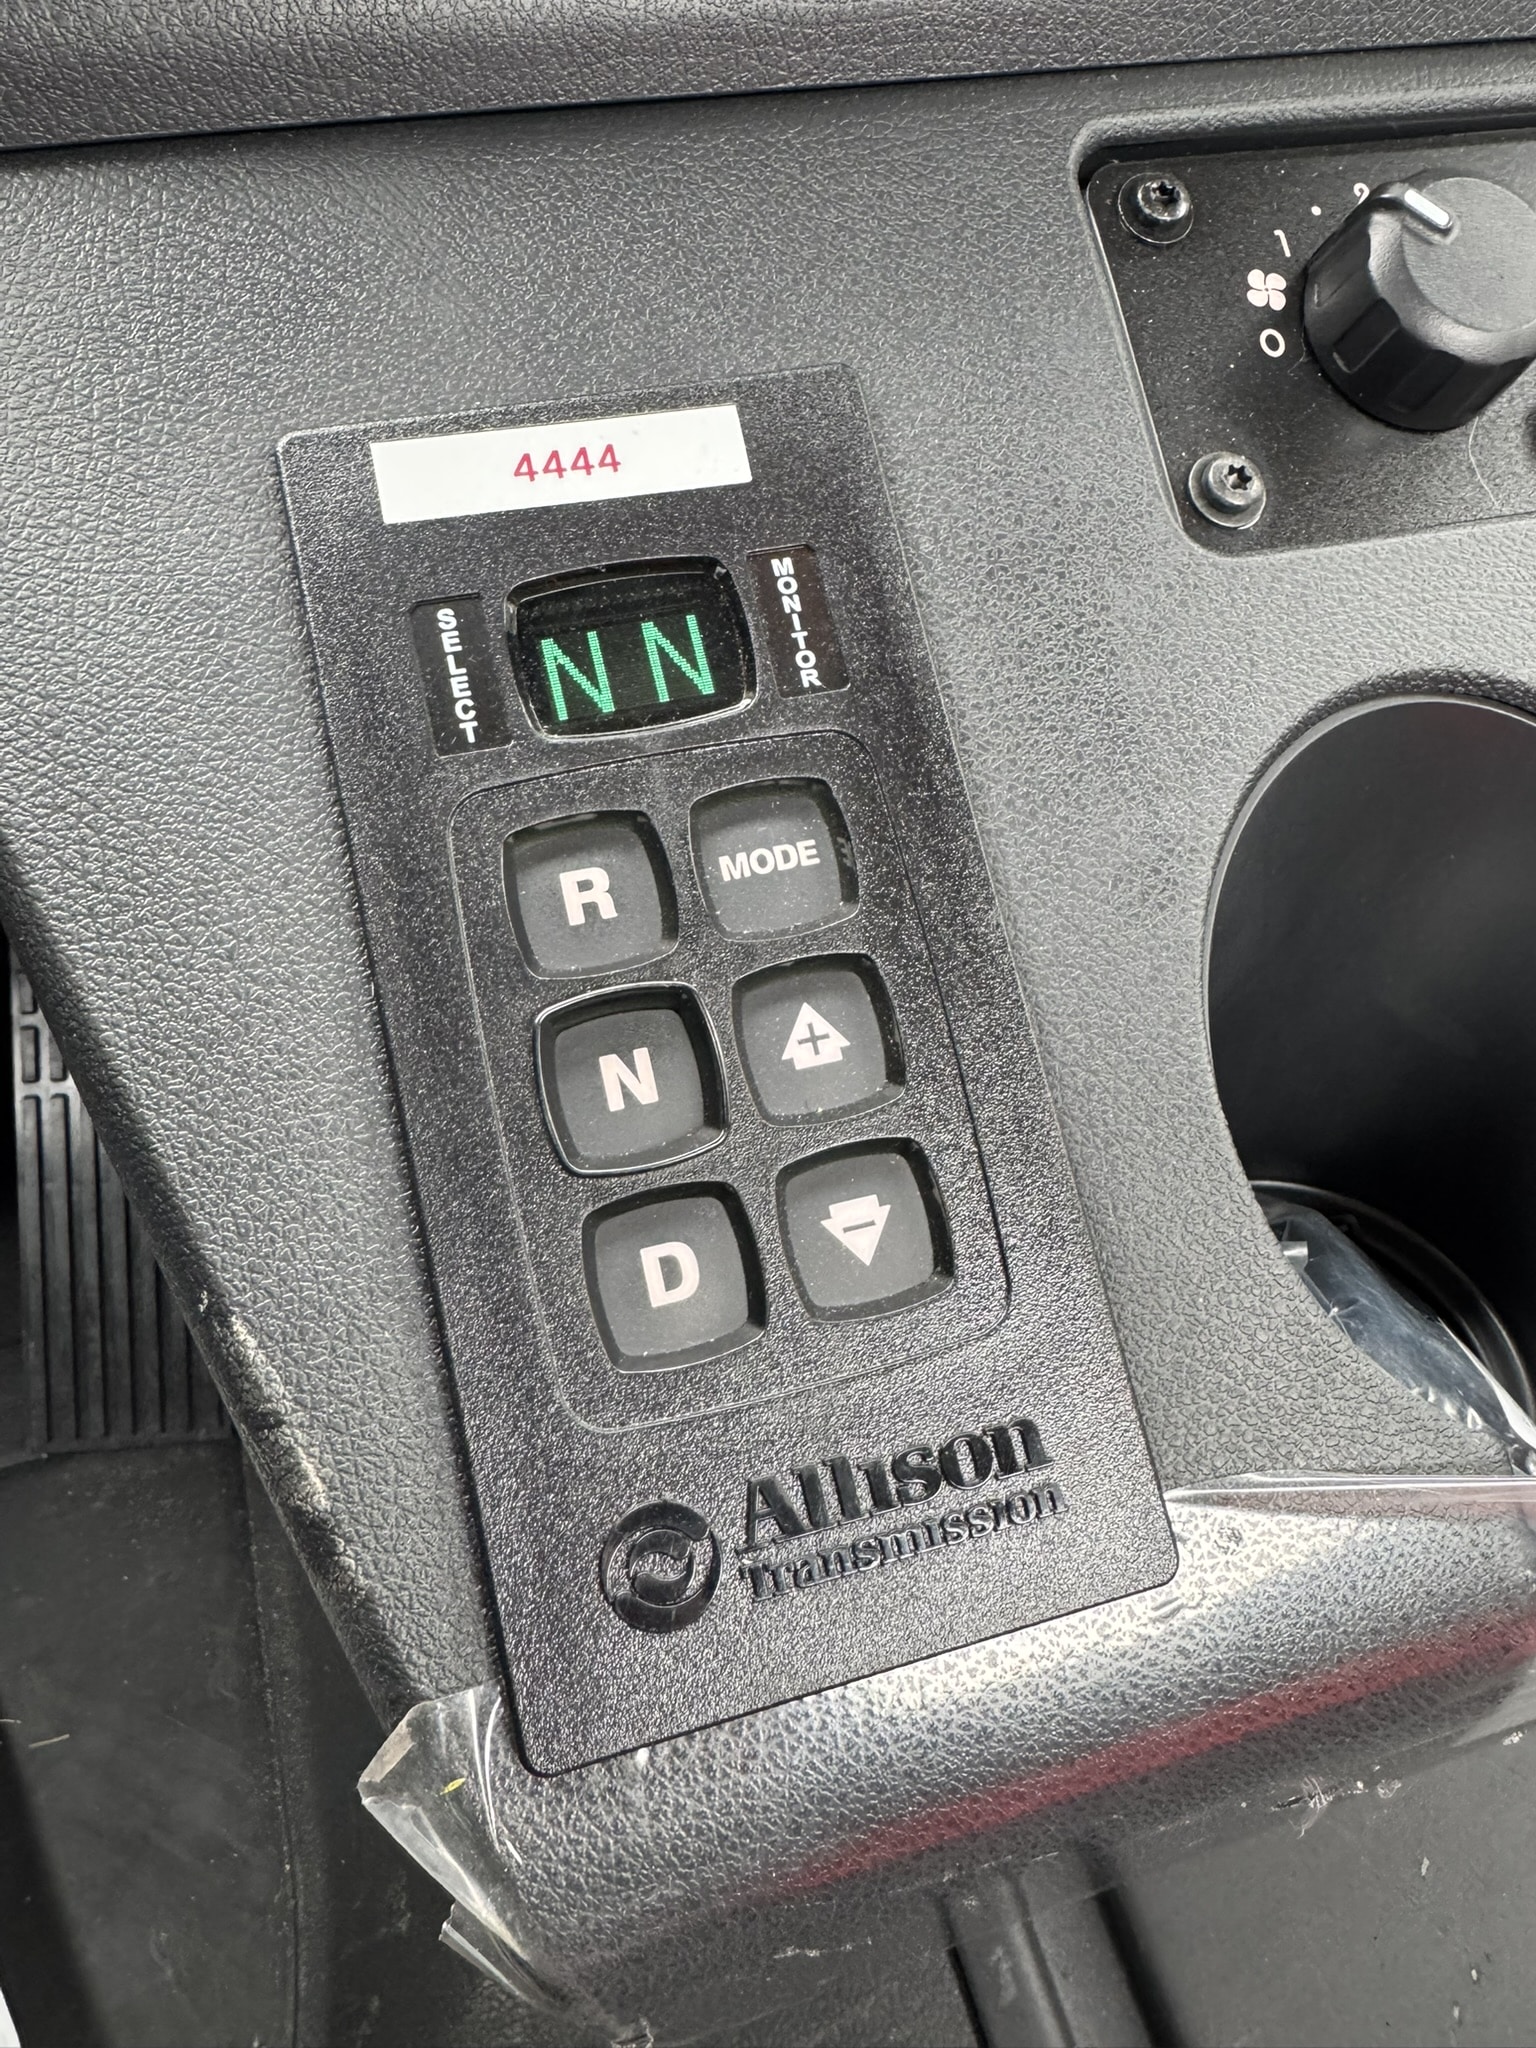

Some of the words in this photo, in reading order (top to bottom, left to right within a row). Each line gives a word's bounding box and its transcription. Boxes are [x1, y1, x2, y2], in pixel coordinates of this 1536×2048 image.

[1273, 229, 1291, 258] 1
[512, 443, 622, 483] 4444
[769, 556, 823, 689] MONITOR
[436, 608, 478, 743] SELECT
[540, 630, 615, 720] N
[641, 614, 715, 702] N
[718, 839, 821, 882] MODE
[559, 866, 618, 927] R
[598, 1047, 660, 1113] N
[639, 1240, 701, 1308] D
[735, 1415, 1055, 1556] Allison
[739, 1480, 1071, 1601] Transmission
